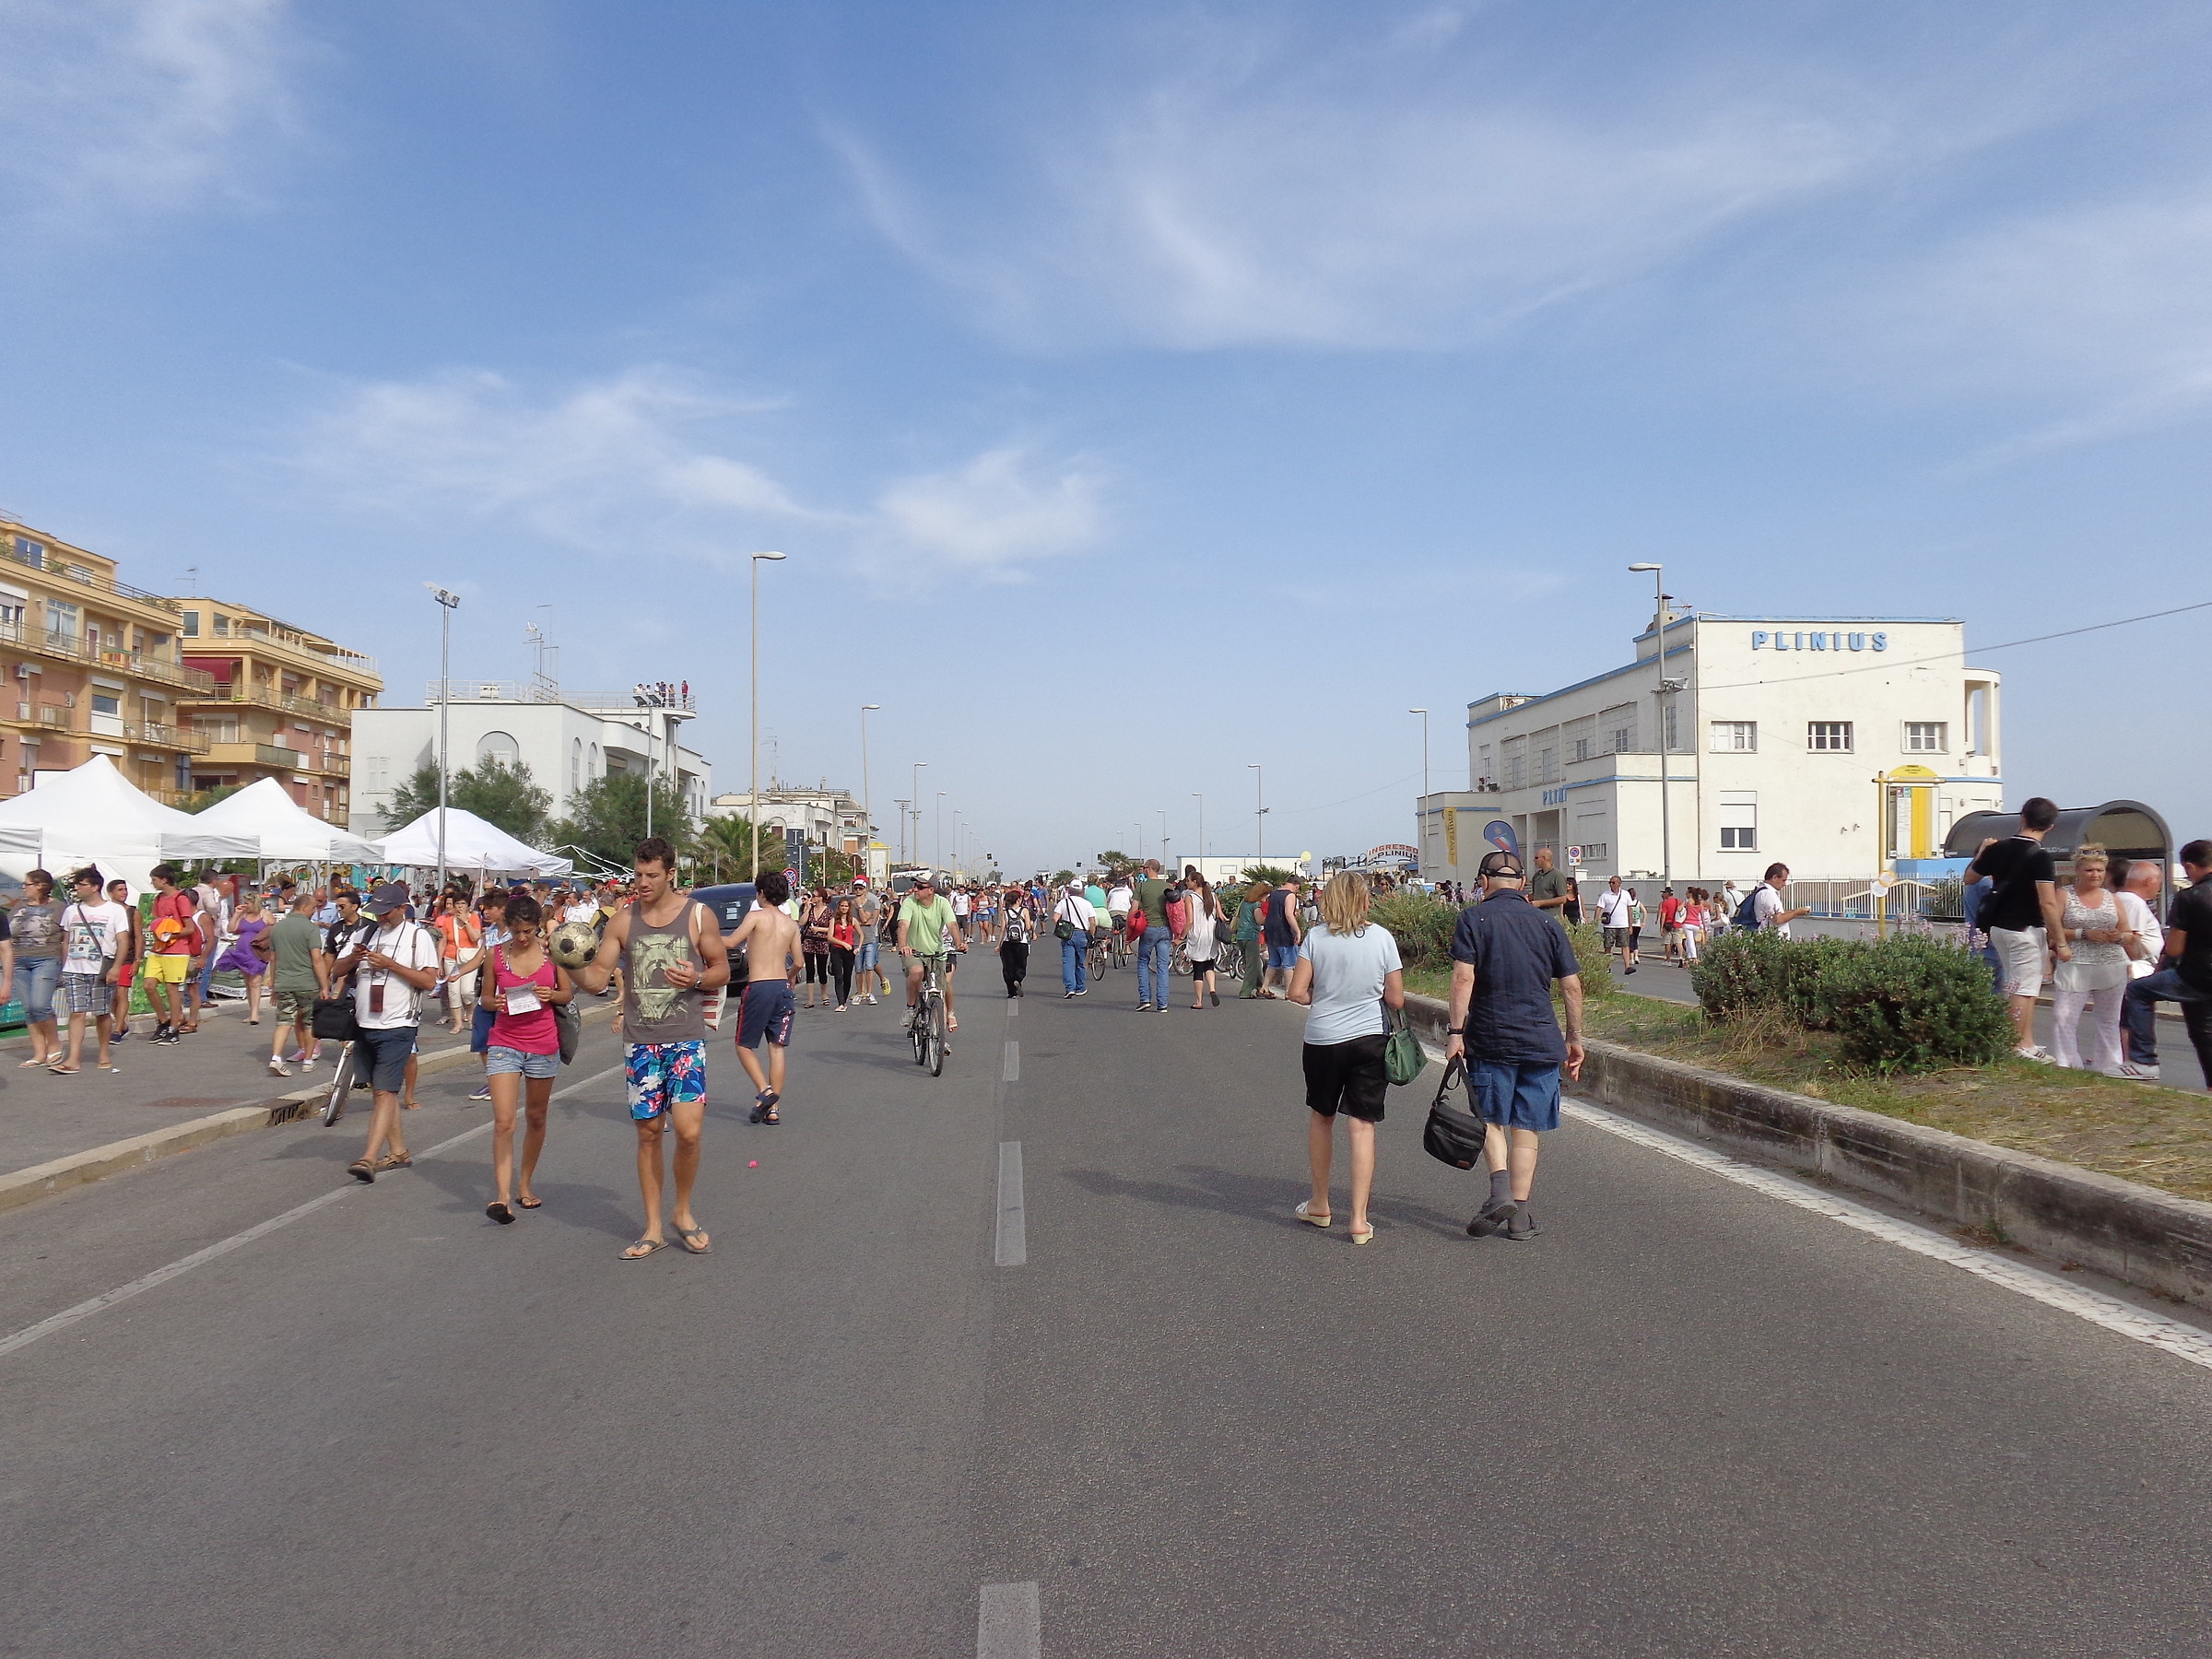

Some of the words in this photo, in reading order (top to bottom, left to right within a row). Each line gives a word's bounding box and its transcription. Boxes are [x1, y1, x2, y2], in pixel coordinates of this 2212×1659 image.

[1752, 631, 1888, 651] PLINIUS
[1369, 843, 1418, 855] INGRESSO
[1377, 850, 1418, 864] PLINIUS
